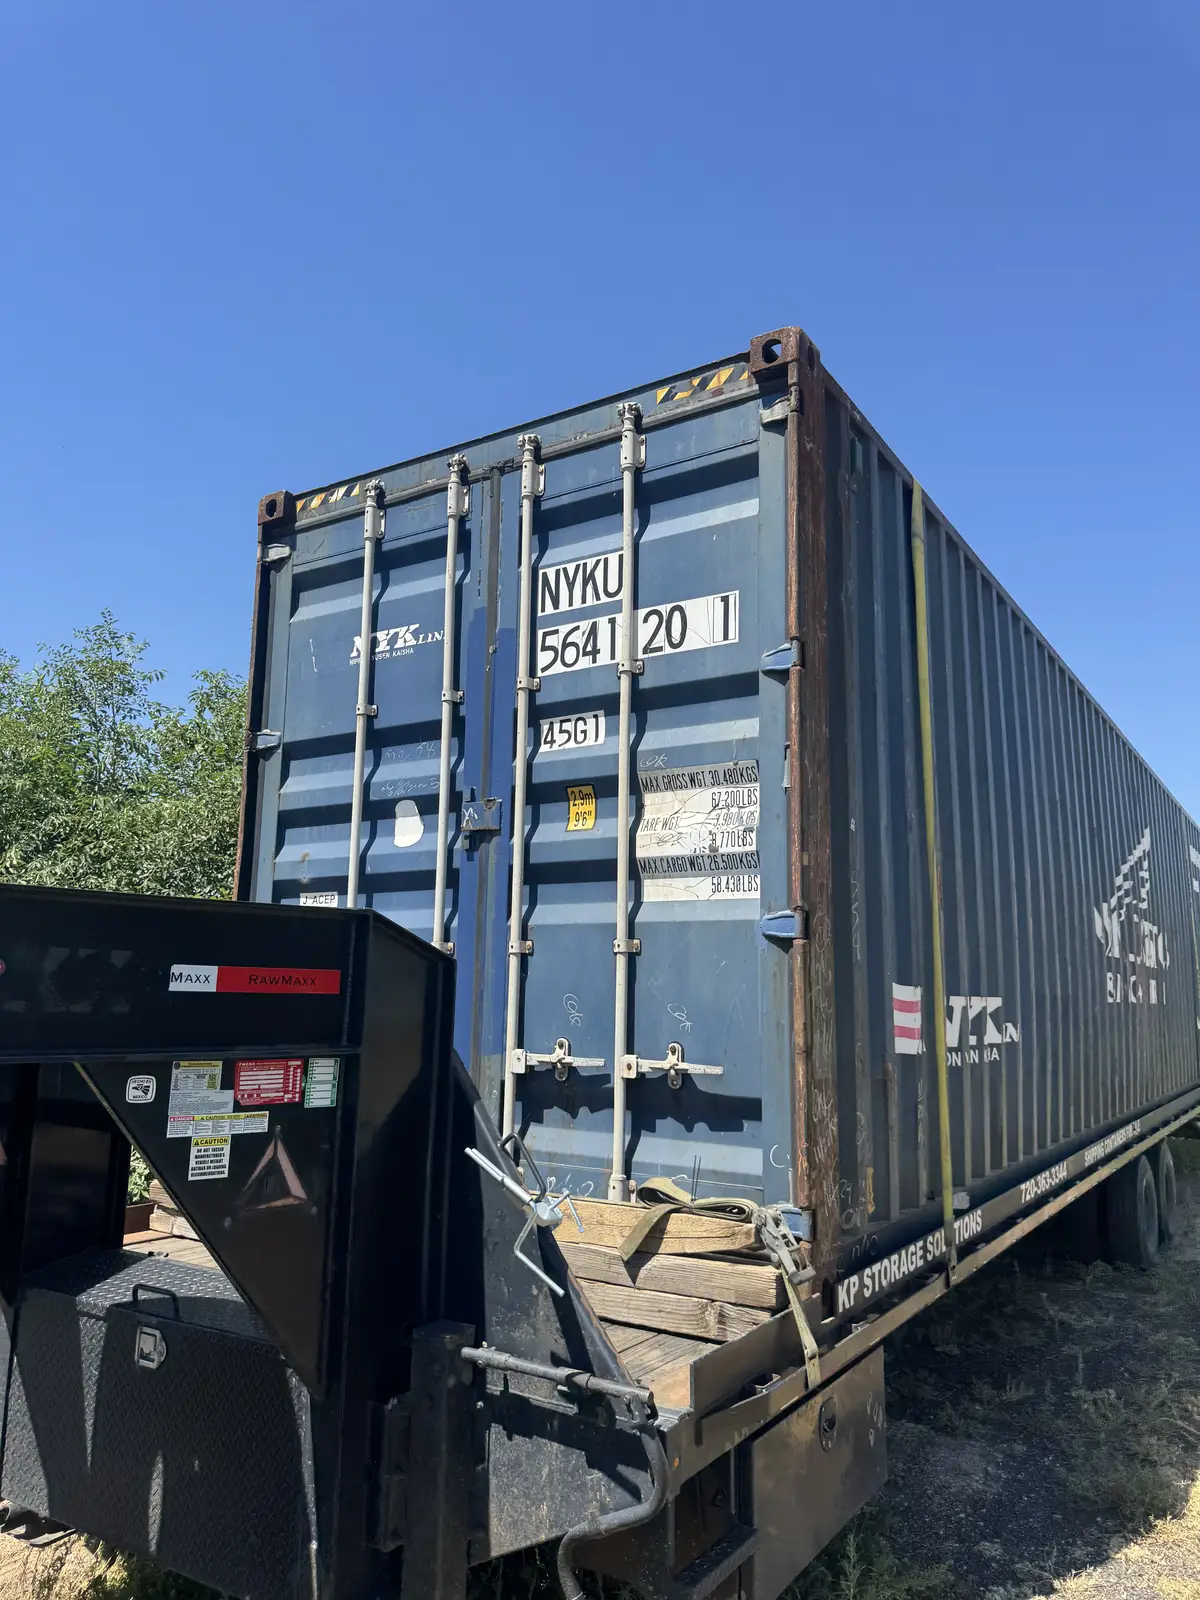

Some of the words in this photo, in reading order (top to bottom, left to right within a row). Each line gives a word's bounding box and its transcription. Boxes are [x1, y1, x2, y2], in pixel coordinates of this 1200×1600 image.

[541, 554, 623, 613] NYKU
[417, 630, 445, 645] LIN
[543, 714, 599, 748] 45G1
[838, 1274, 859, 1312] KP
[863, 1240, 924, 1298] STORAGE
[926, 1209, 983, 1261] SOLTIONS
